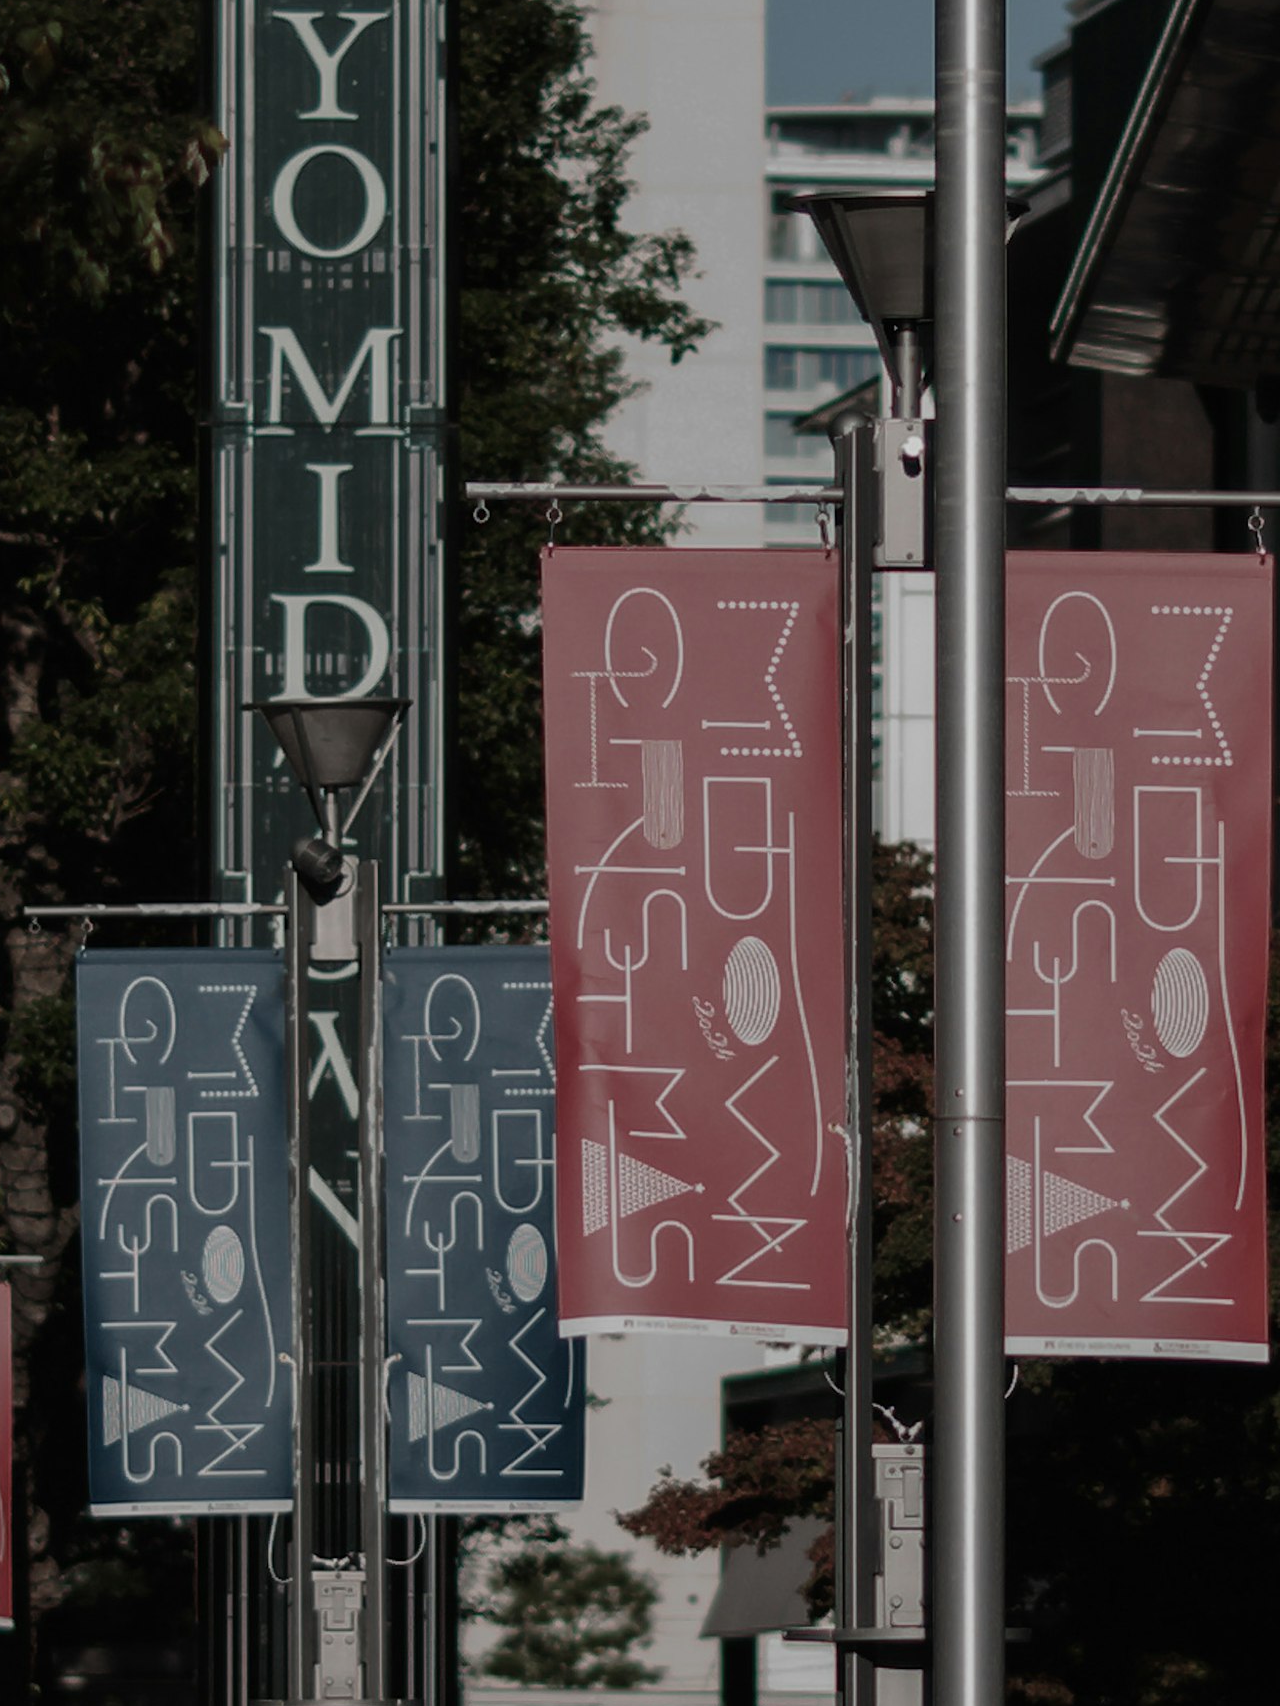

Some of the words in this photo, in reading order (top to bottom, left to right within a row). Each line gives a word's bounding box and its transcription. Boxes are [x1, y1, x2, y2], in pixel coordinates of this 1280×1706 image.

[96, 975, 191, 1483] CHRISTMAS
[186, 984, 276, 1477] MIDTOWN
[401, 973, 494, 1482] CHRISTMAS
[570, 586, 706, 1290] CHRISTMAS
[701, 599, 824, 1291] MIDTOWN
[1132, 604, 1249, 1306] MIDTOWN
